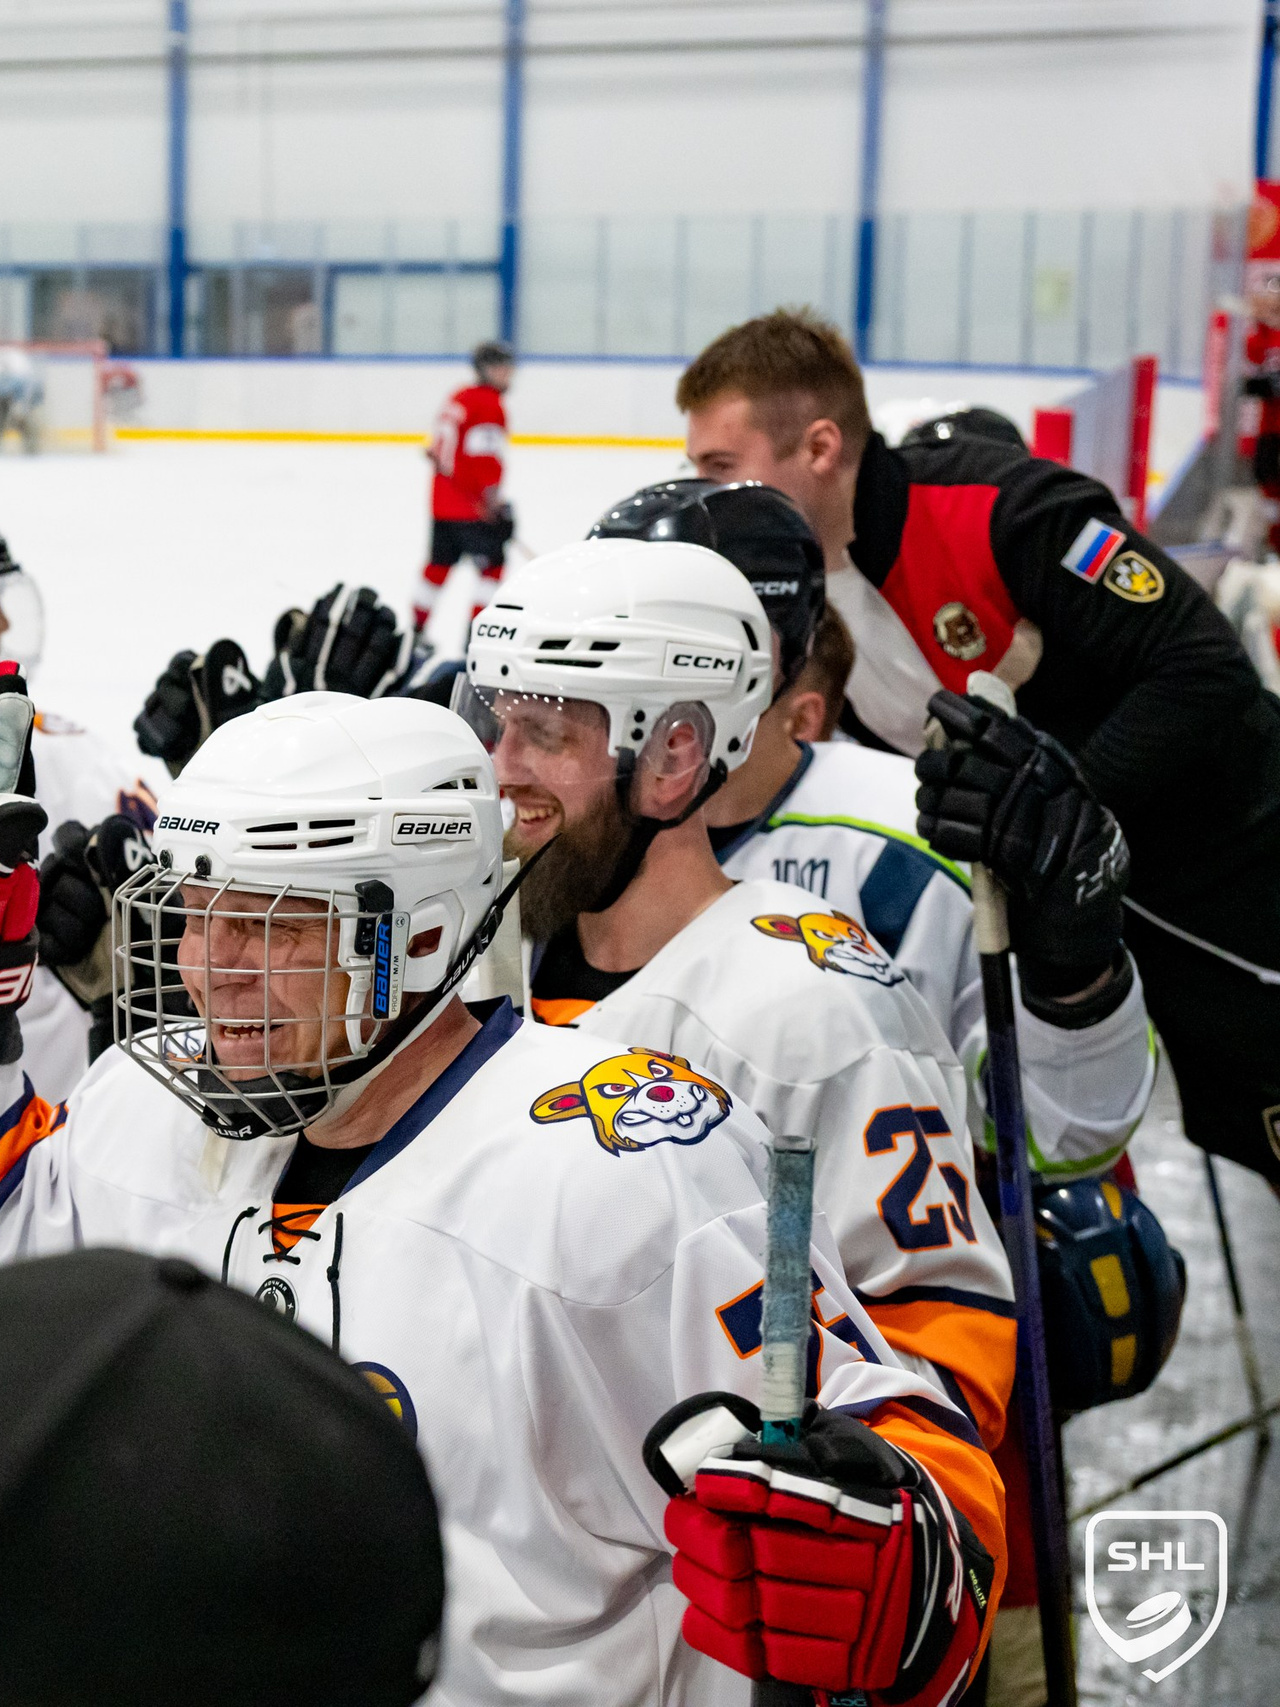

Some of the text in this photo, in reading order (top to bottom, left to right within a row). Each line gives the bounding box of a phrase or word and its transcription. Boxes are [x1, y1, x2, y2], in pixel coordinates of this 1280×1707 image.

[477, 624, 517, 640] CCM
[672, 654, 734, 671] CCM
[391, 984, 399, 1012] PROFILE
